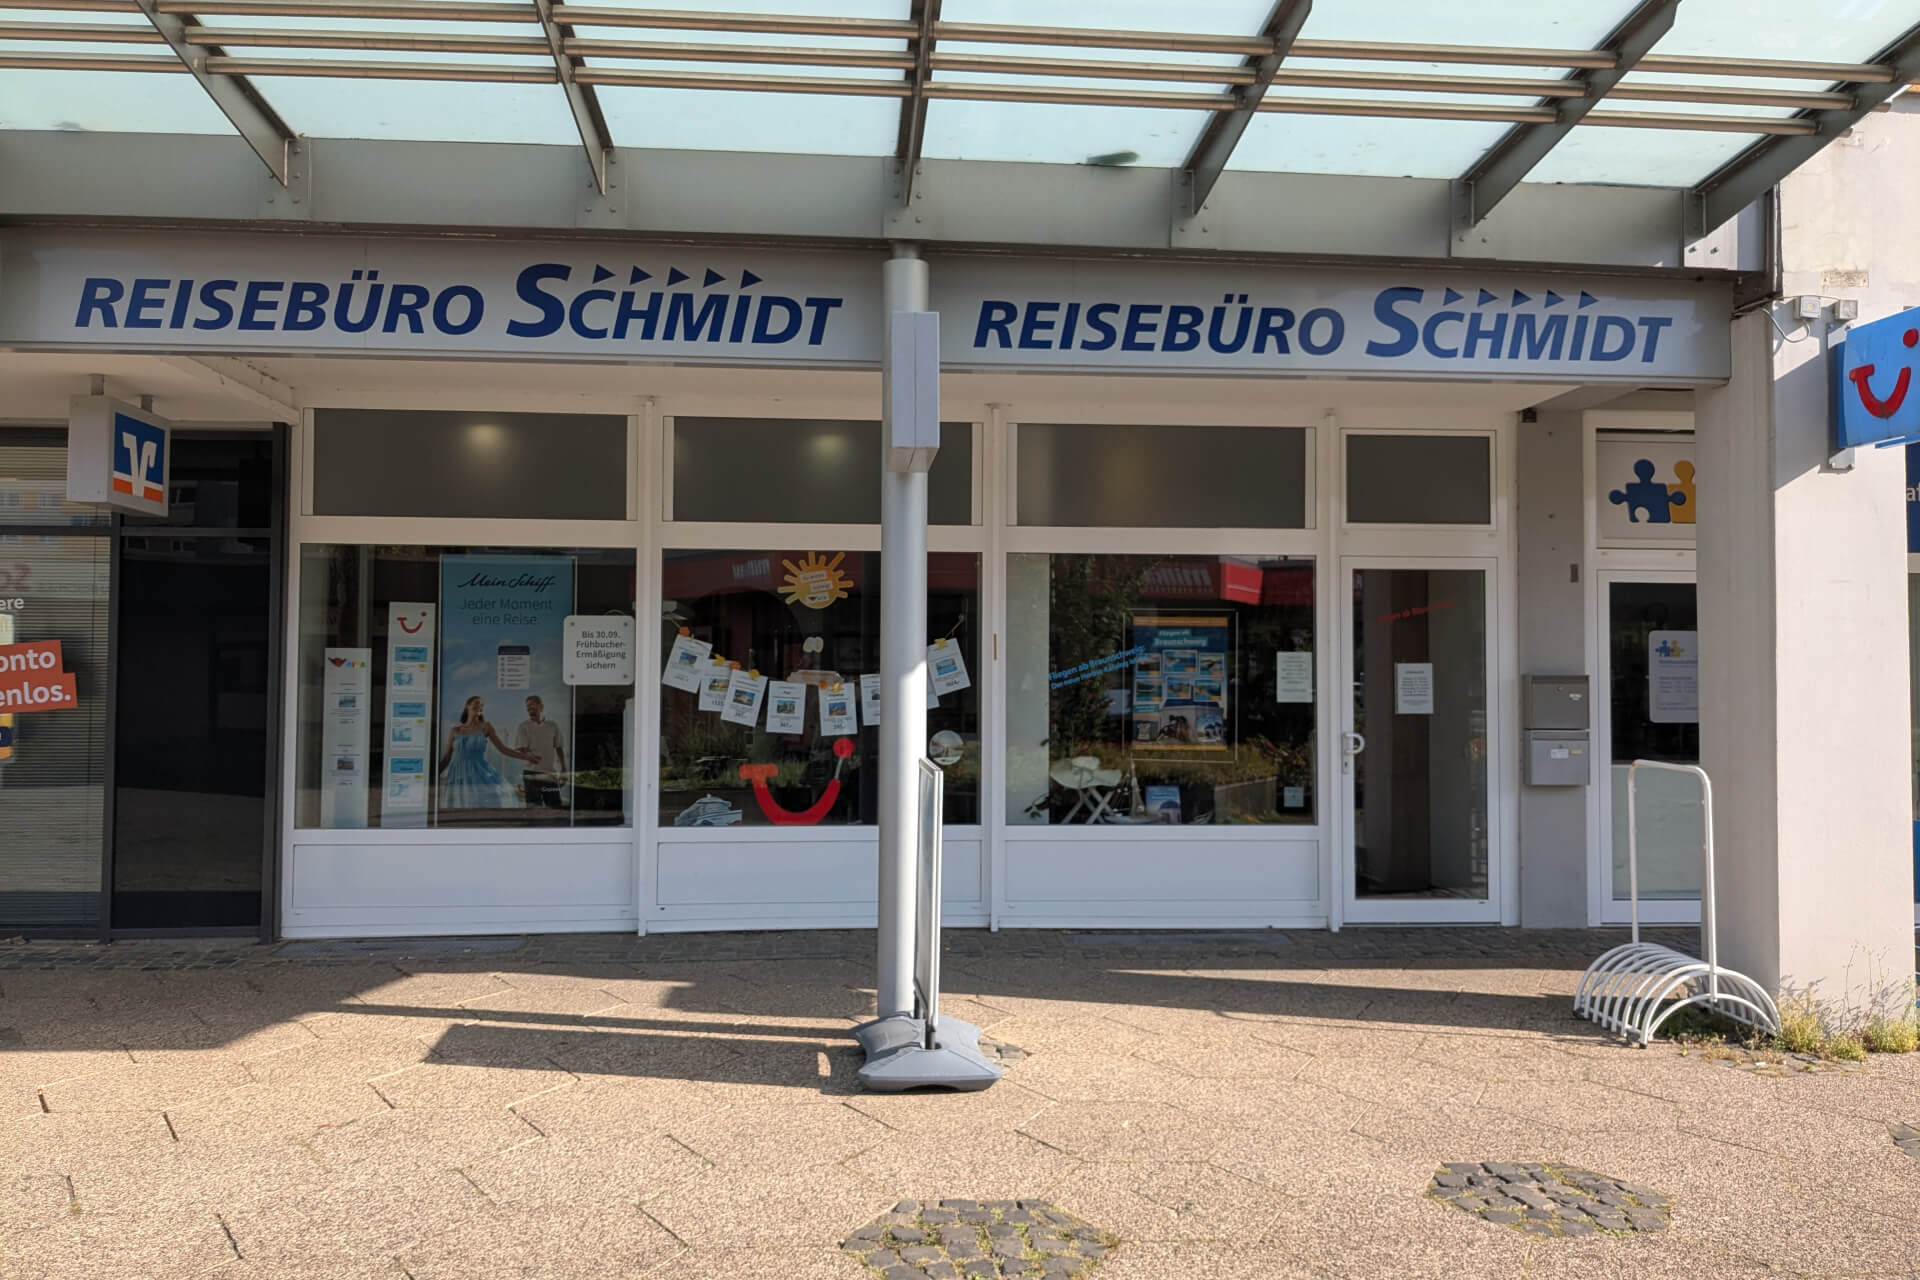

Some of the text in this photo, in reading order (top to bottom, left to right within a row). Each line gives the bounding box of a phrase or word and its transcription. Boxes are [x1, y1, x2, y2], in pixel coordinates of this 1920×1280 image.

[75, 262, 843, 346] REISEBÜRO SCHMIDT
[973, 287, 1673, 364] REISEBÜRO SCHMIDT
[457, 572, 558, 593] Mein Schiff
[461, 598, 552, 610] Jeder Moment
[472, 613, 537, 625] eine Reise
[582, 631, 594, 639] Bis
[576, 650, 627, 660] Ermäßigung
[585, 661, 616, 669] sichern
